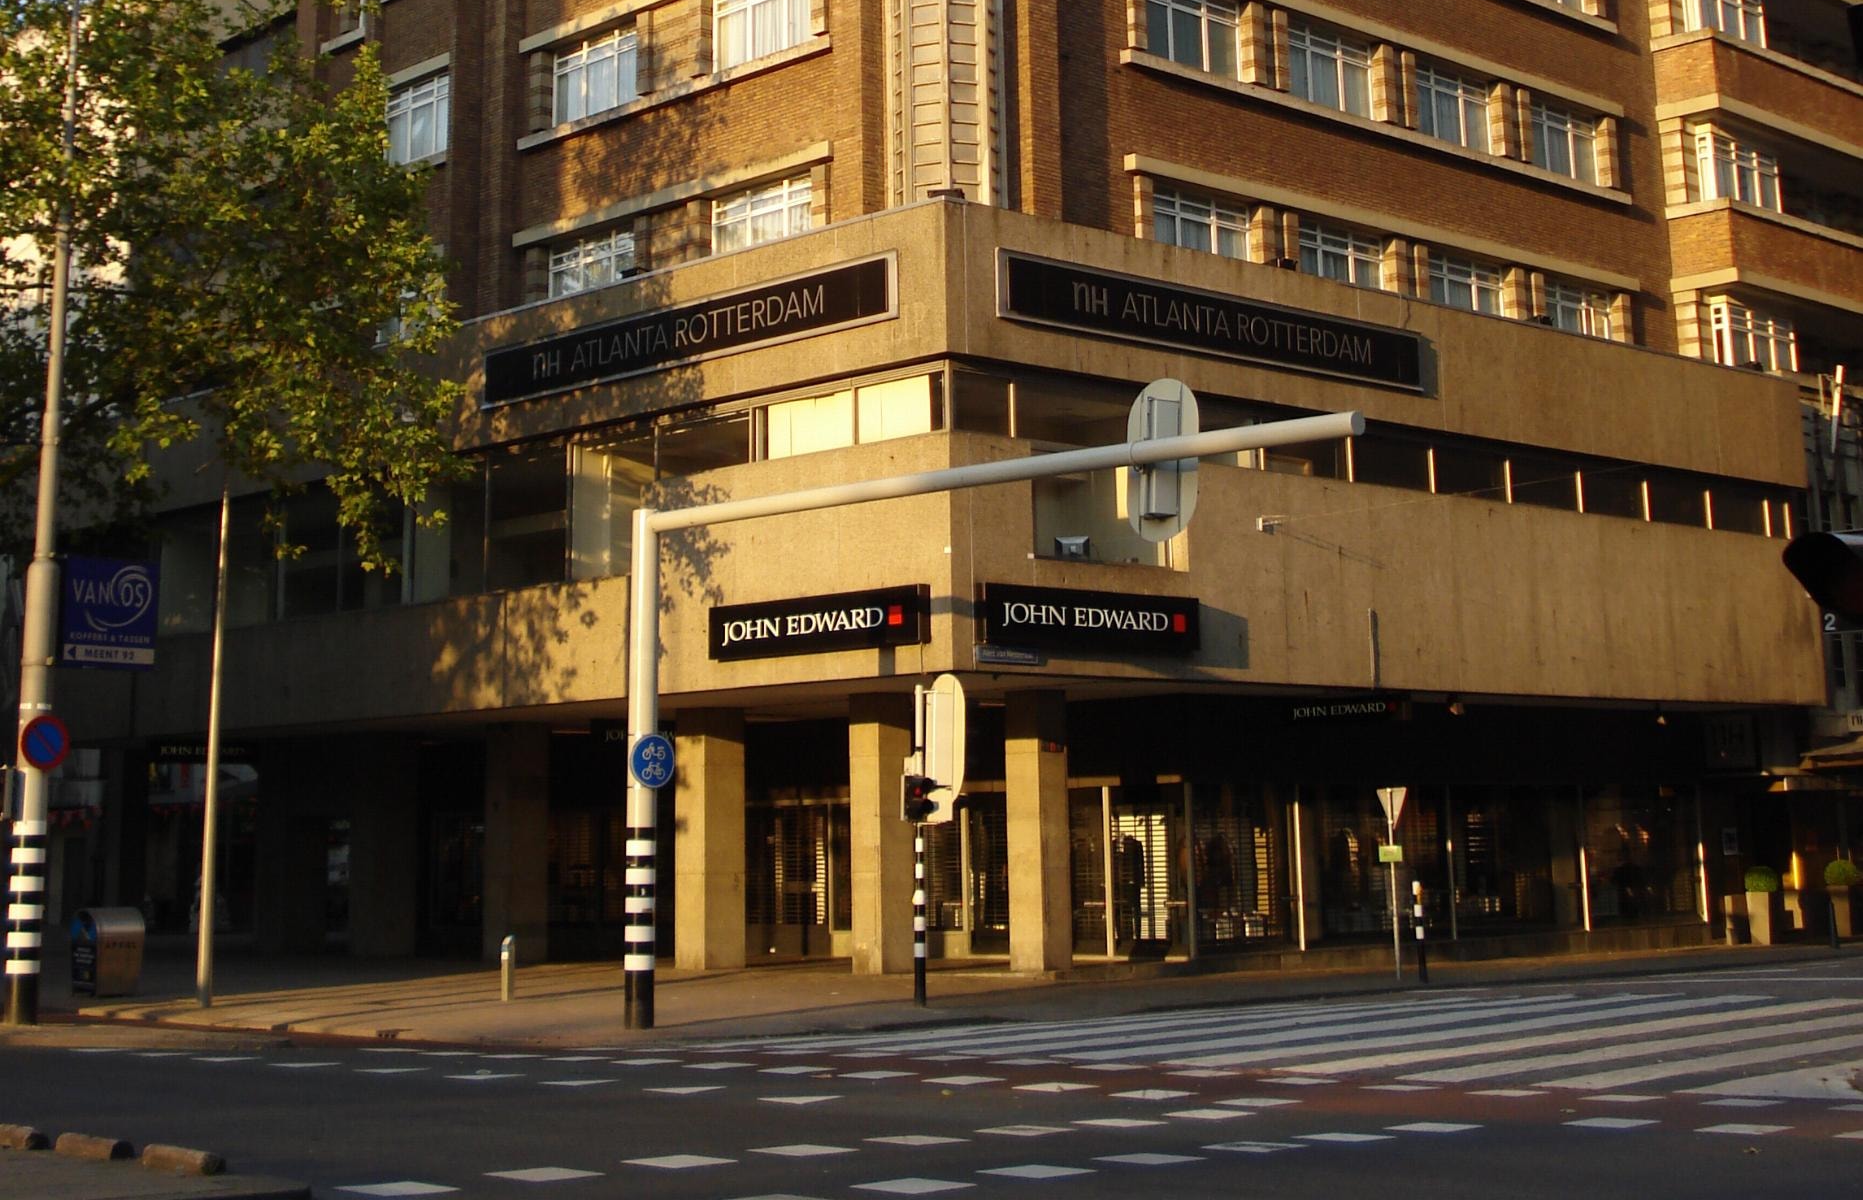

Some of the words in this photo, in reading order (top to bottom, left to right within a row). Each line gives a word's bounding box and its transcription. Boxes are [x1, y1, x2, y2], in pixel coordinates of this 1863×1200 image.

[570, 323, 668, 371] ATLANTA
[674, 284, 825, 349] ROTTERDAM
[1121, 291, 1231, 340] ATLANTA
[1237, 313, 1373, 366] ROTTERDAM
[72, 578, 110, 605] VAN
[722, 616, 780, 647] JOHN
[786, 607, 884, 637] EDWARD
[1003, 602, 1068, 627] JOHN
[1073, 606, 1169, 632] EDWARD
[84, 647, 119, 659] MEENT
[1293, 706, 1327, 719] JOHN
[1330, 702, 1386, 715] EDWARD
